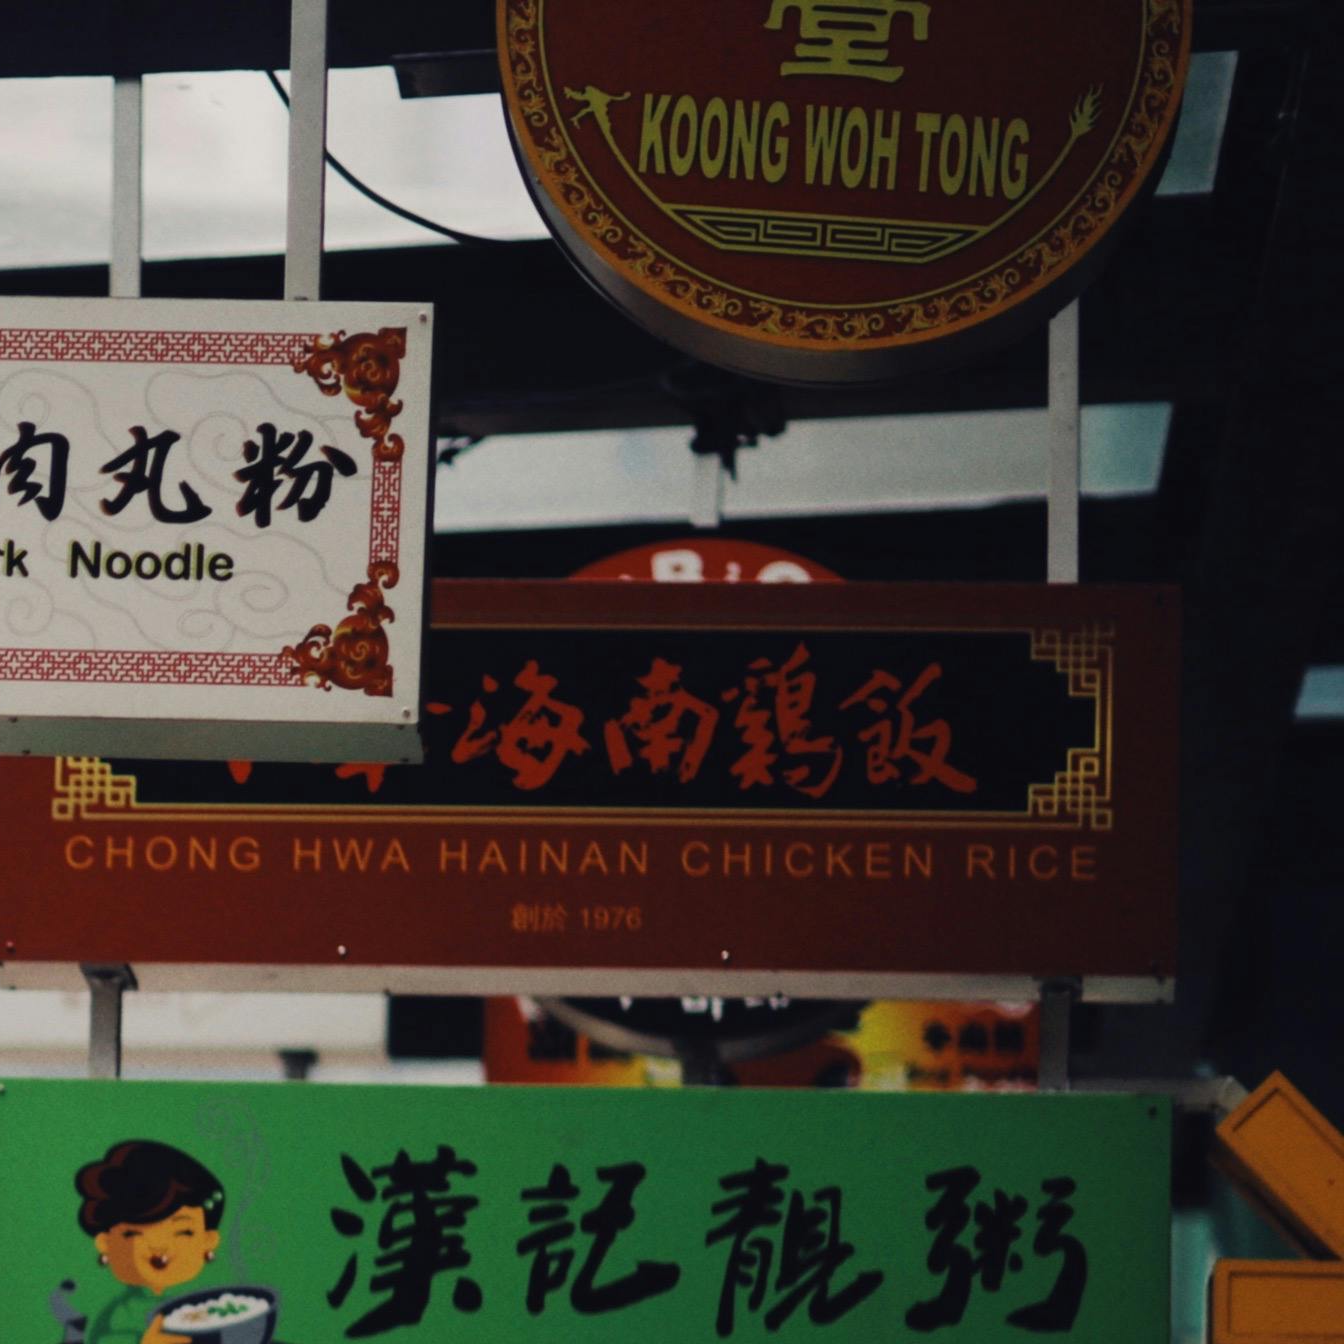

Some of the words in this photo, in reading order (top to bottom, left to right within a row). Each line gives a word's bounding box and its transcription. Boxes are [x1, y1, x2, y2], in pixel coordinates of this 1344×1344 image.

[638, 93, 789, 184] KOONG
[805, 104, 901, 192] WOH
[917, 113, 1030, 199] TONG
[68, 541, 236, 583] Noodle
[64, 834, 261, 874] CHONG
[293, 836, 412, 875] HWA
[441, 838, 650, 878] HAINAN
[680, 839, 934, 881] CHICKEN
[967, 843, 1101, 883] RICE
[581, 905, 643, 931] 1976
[325, 1142, 1091, 1341] 漢記靚粥
